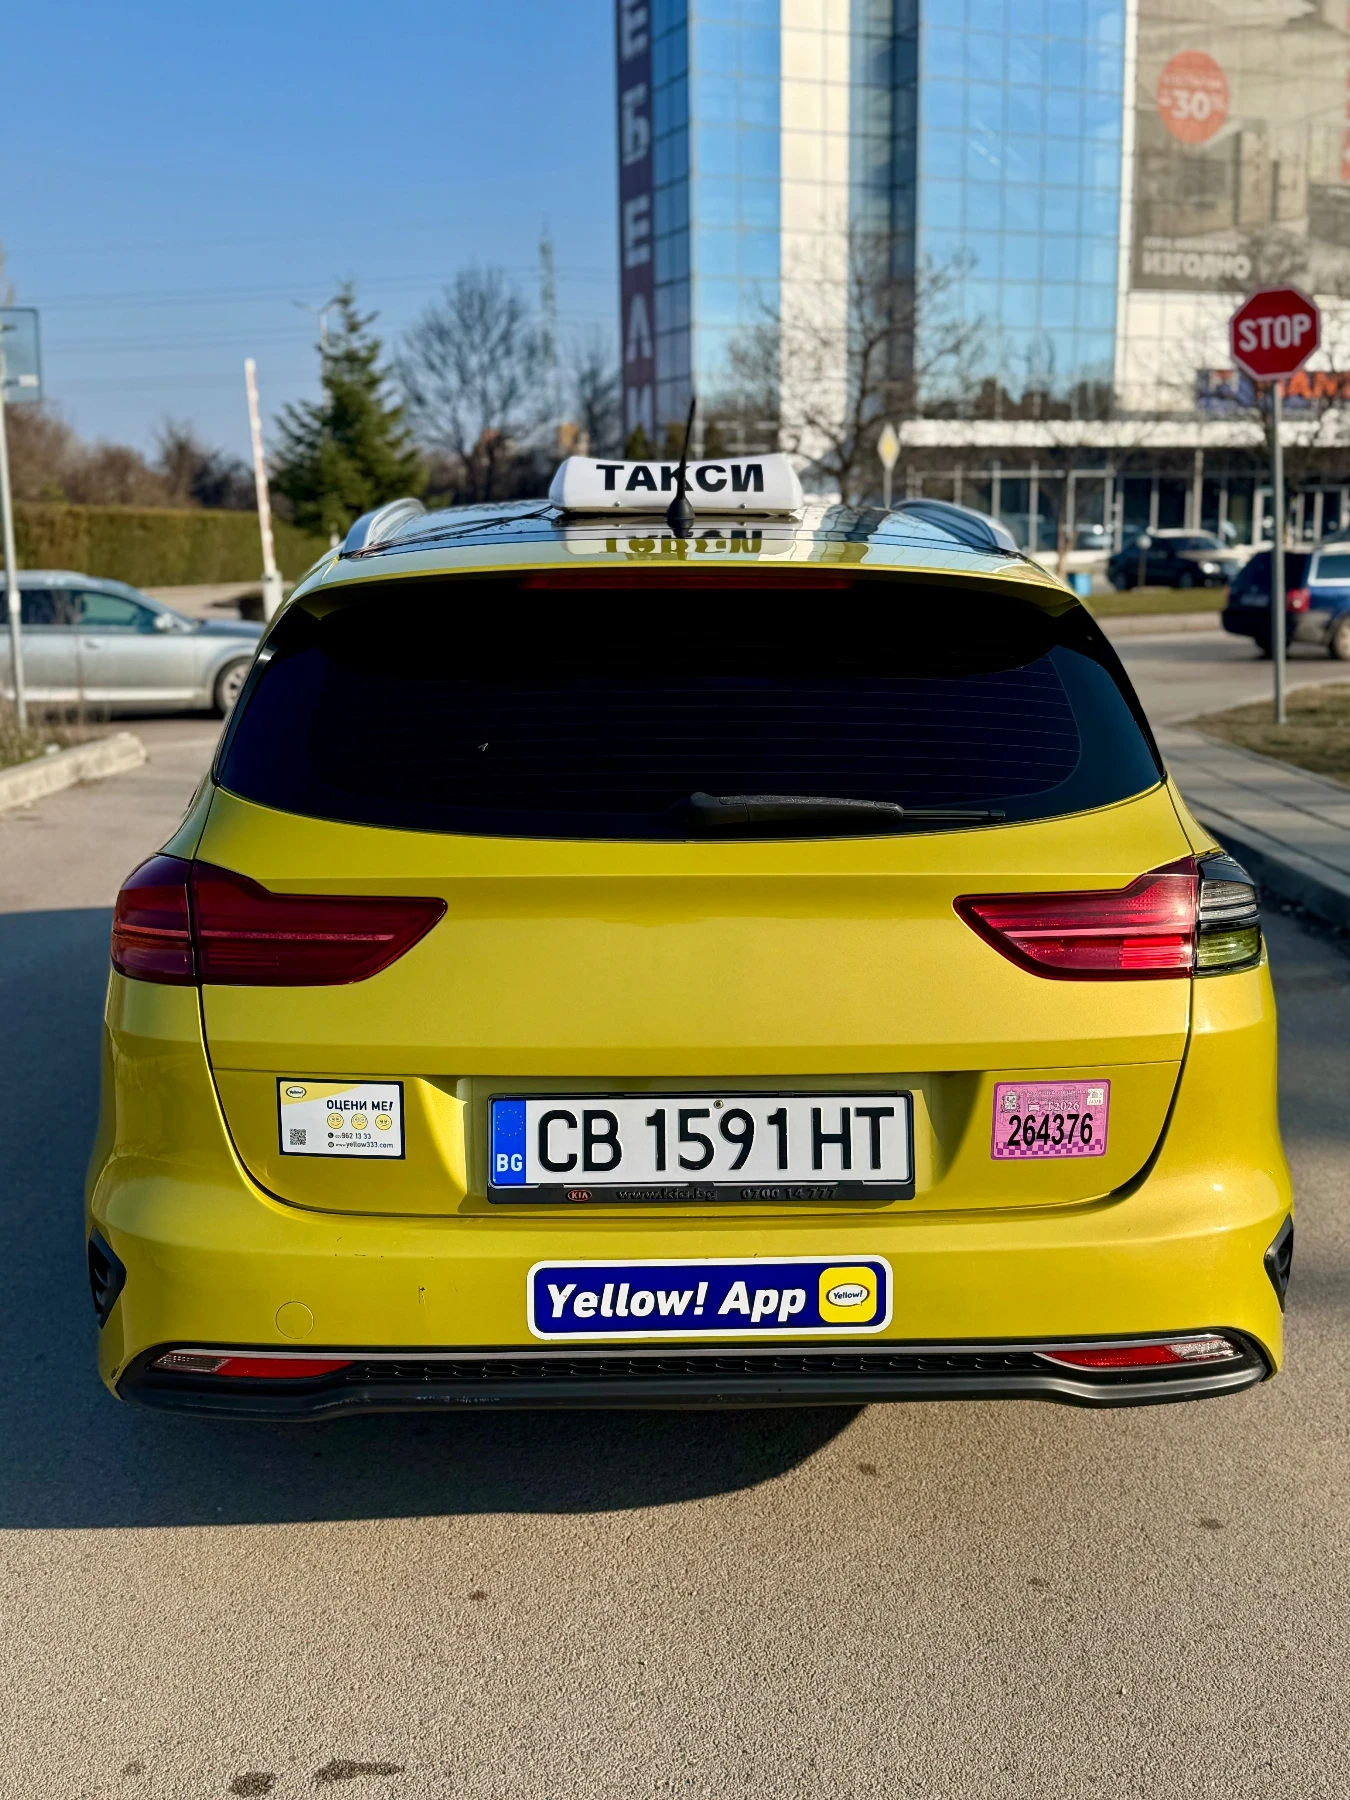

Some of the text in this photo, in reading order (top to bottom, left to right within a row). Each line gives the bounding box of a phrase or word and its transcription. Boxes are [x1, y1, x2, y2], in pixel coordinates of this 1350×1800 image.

[1238, 313, 1312, 352] STOP
[596, 463, 764, 492] ТАКСИ
[326, 1099, 394, 1112] ОЦЕНИ МЕ!
[537, 1106, 894, 1173] CB 1591 HT
[1007, 1113, 1093, 1147] 264376
[496, 1153, 523, 1172] BG
[571, 1191, 588, 1199] KIA
[616, 1188, 717, 1201] www.kia.bg
[784, 1188, 804, 1200] 14
[808, 1187, 837, 1199] 777
[547, 1280, 806, 1322] Yellow! App
[833, 1289, 863, 1301] Yellow!
